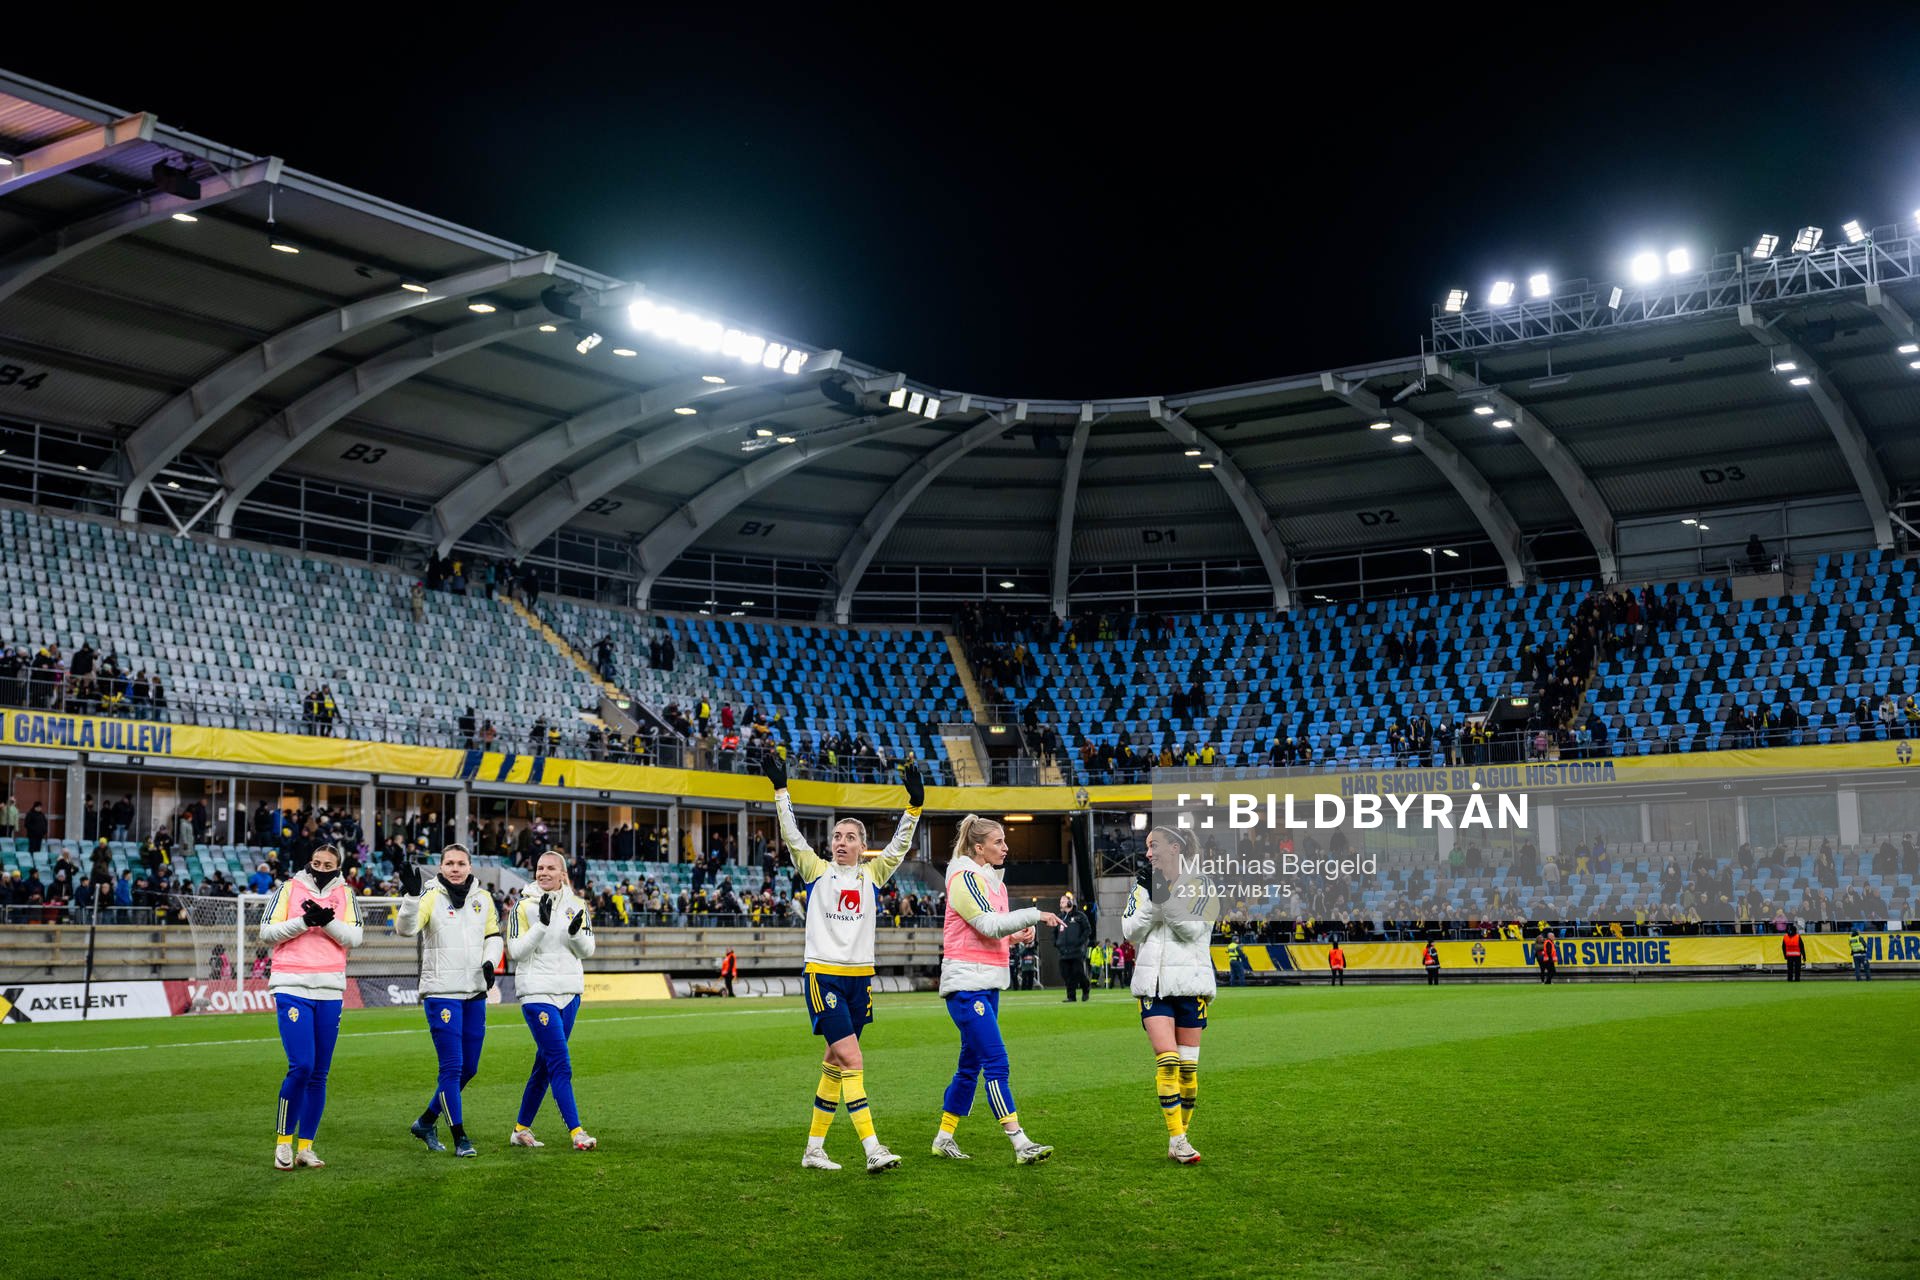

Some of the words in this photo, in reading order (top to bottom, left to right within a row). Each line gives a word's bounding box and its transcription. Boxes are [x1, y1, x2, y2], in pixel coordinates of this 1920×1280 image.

[0, 365, 48, 390] B4
[341, 443, 387, 464] B3
[1700, 466, 1746, 484] D3
[583, 498, 622, 515] B2
[1356, 510, 1400, 526] D2
[738, 521, 776, 537] B1
[1142, 530, 1176, 543] D1
[14, 714, 95, 747] GAMLA
[100, 721, 172, 754] ULLEVI
[1341, 774, 1378, 796] HÄR
[1381, 770, 1448, 794] SKRIVS
[1452, 767, 1523, 791] BLÅGUL
[1525, 760, 1616, 786] HISTORIA
[825, 912, 855, 921] SVENSKA
[1582, 941, 1671, 965] SVERIGE
[1888, 935, 1920, 960] ÄR
[30, 995, 127, 1011] AXELENT
